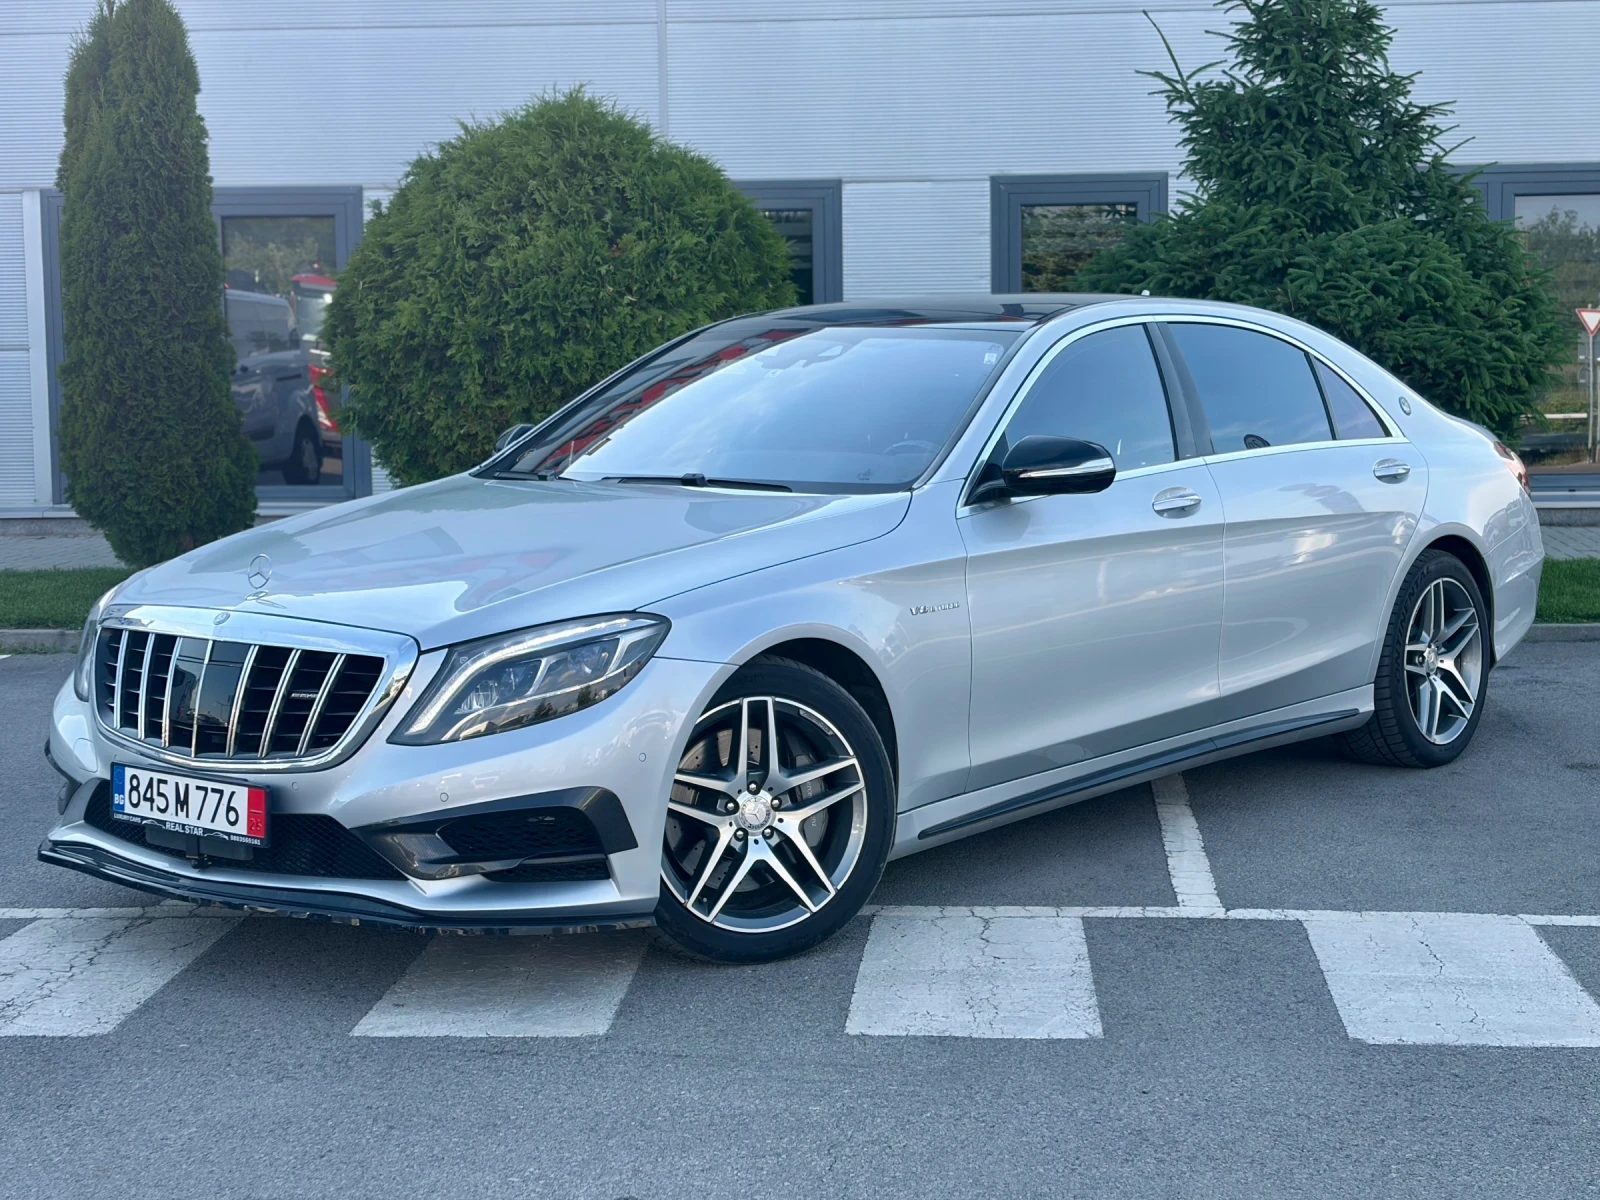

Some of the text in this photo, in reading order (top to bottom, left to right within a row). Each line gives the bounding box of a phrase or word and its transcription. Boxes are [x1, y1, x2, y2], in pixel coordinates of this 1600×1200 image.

[114, 793, 125, 805] BG
[128, 773, 240, 827] 845 M 776
[165, 821, 204, 837] REAL STAR
